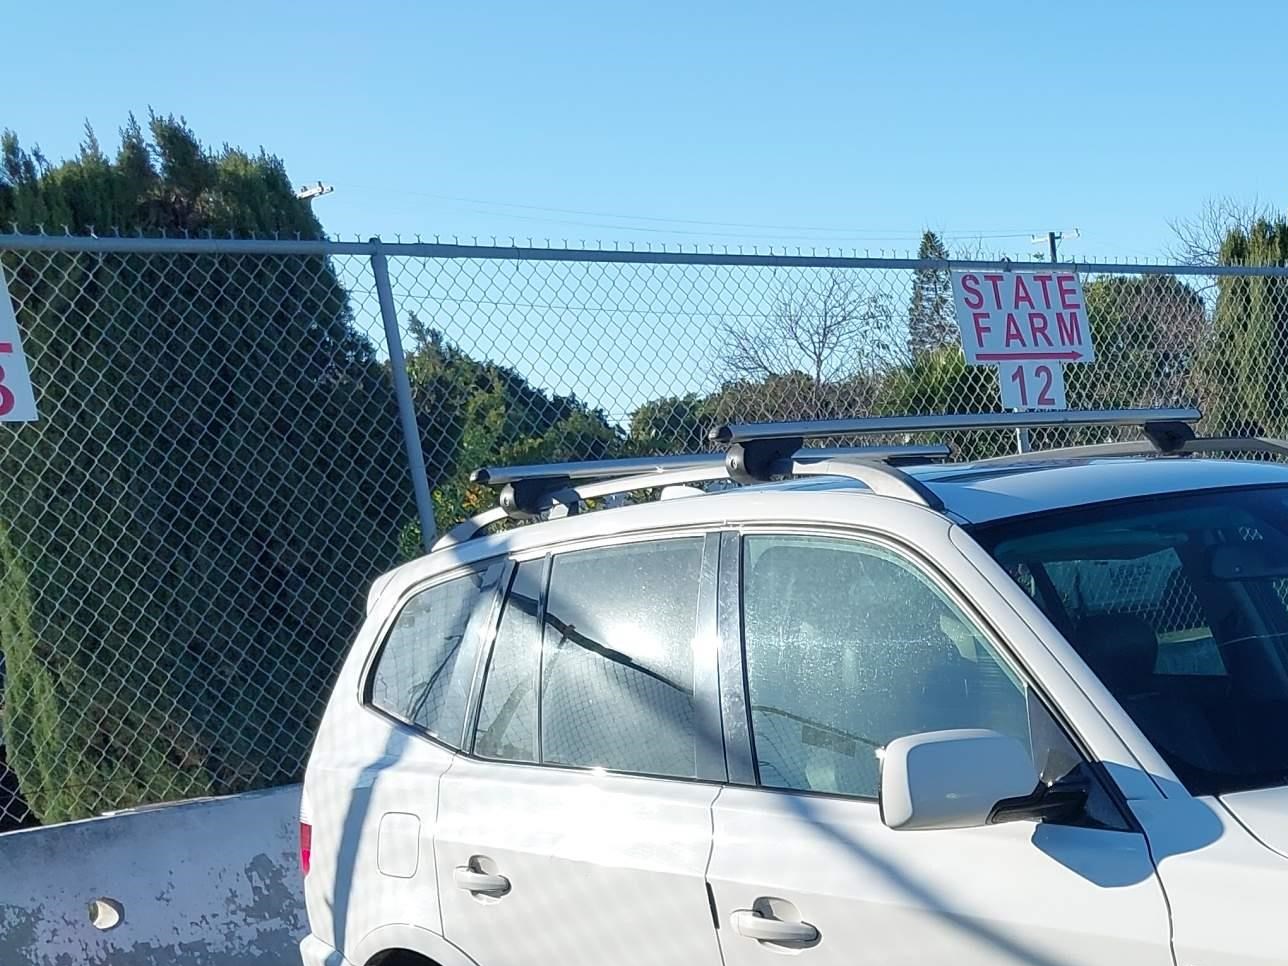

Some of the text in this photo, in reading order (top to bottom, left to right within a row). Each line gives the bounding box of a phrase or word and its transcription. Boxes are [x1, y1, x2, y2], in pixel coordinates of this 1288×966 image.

[961, 273, 1081, 310] STATE
[972, 311, 1083, 348] FARM
[1011, 364, 1056, 406] 12
